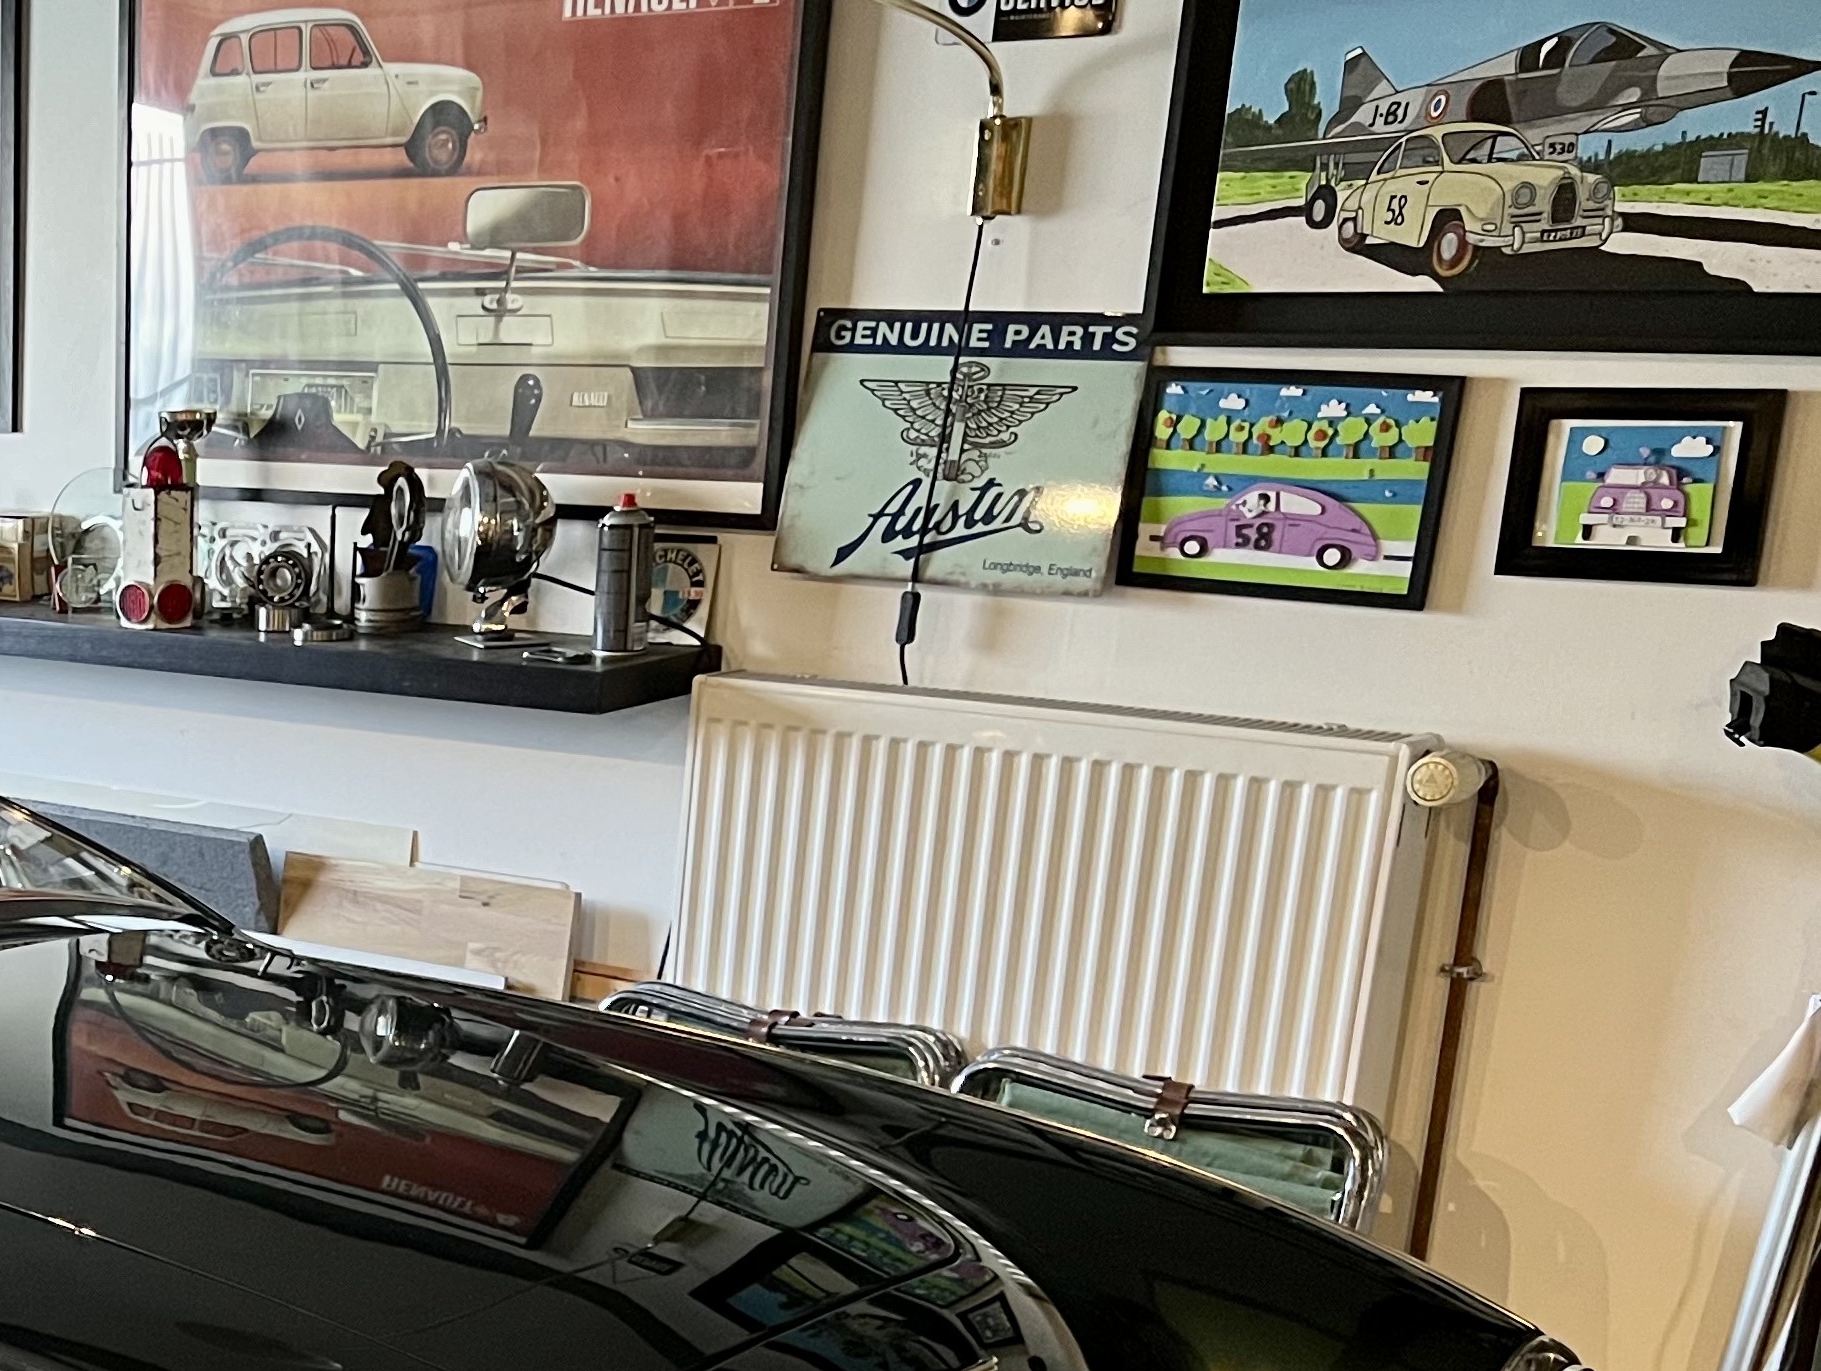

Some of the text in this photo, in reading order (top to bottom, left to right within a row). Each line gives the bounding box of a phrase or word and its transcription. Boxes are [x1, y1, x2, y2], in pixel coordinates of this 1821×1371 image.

[1547, 141, 1576, 156] 530
[1383, 194, 1408, 227] 58
[829, 319, 1140, 353] GENUINE PARTS
[830, 477, 1045, 569] Austin
[1234, 521, 1277, 551] 58
[982, 558, 1095, 580] Longbridge, England
